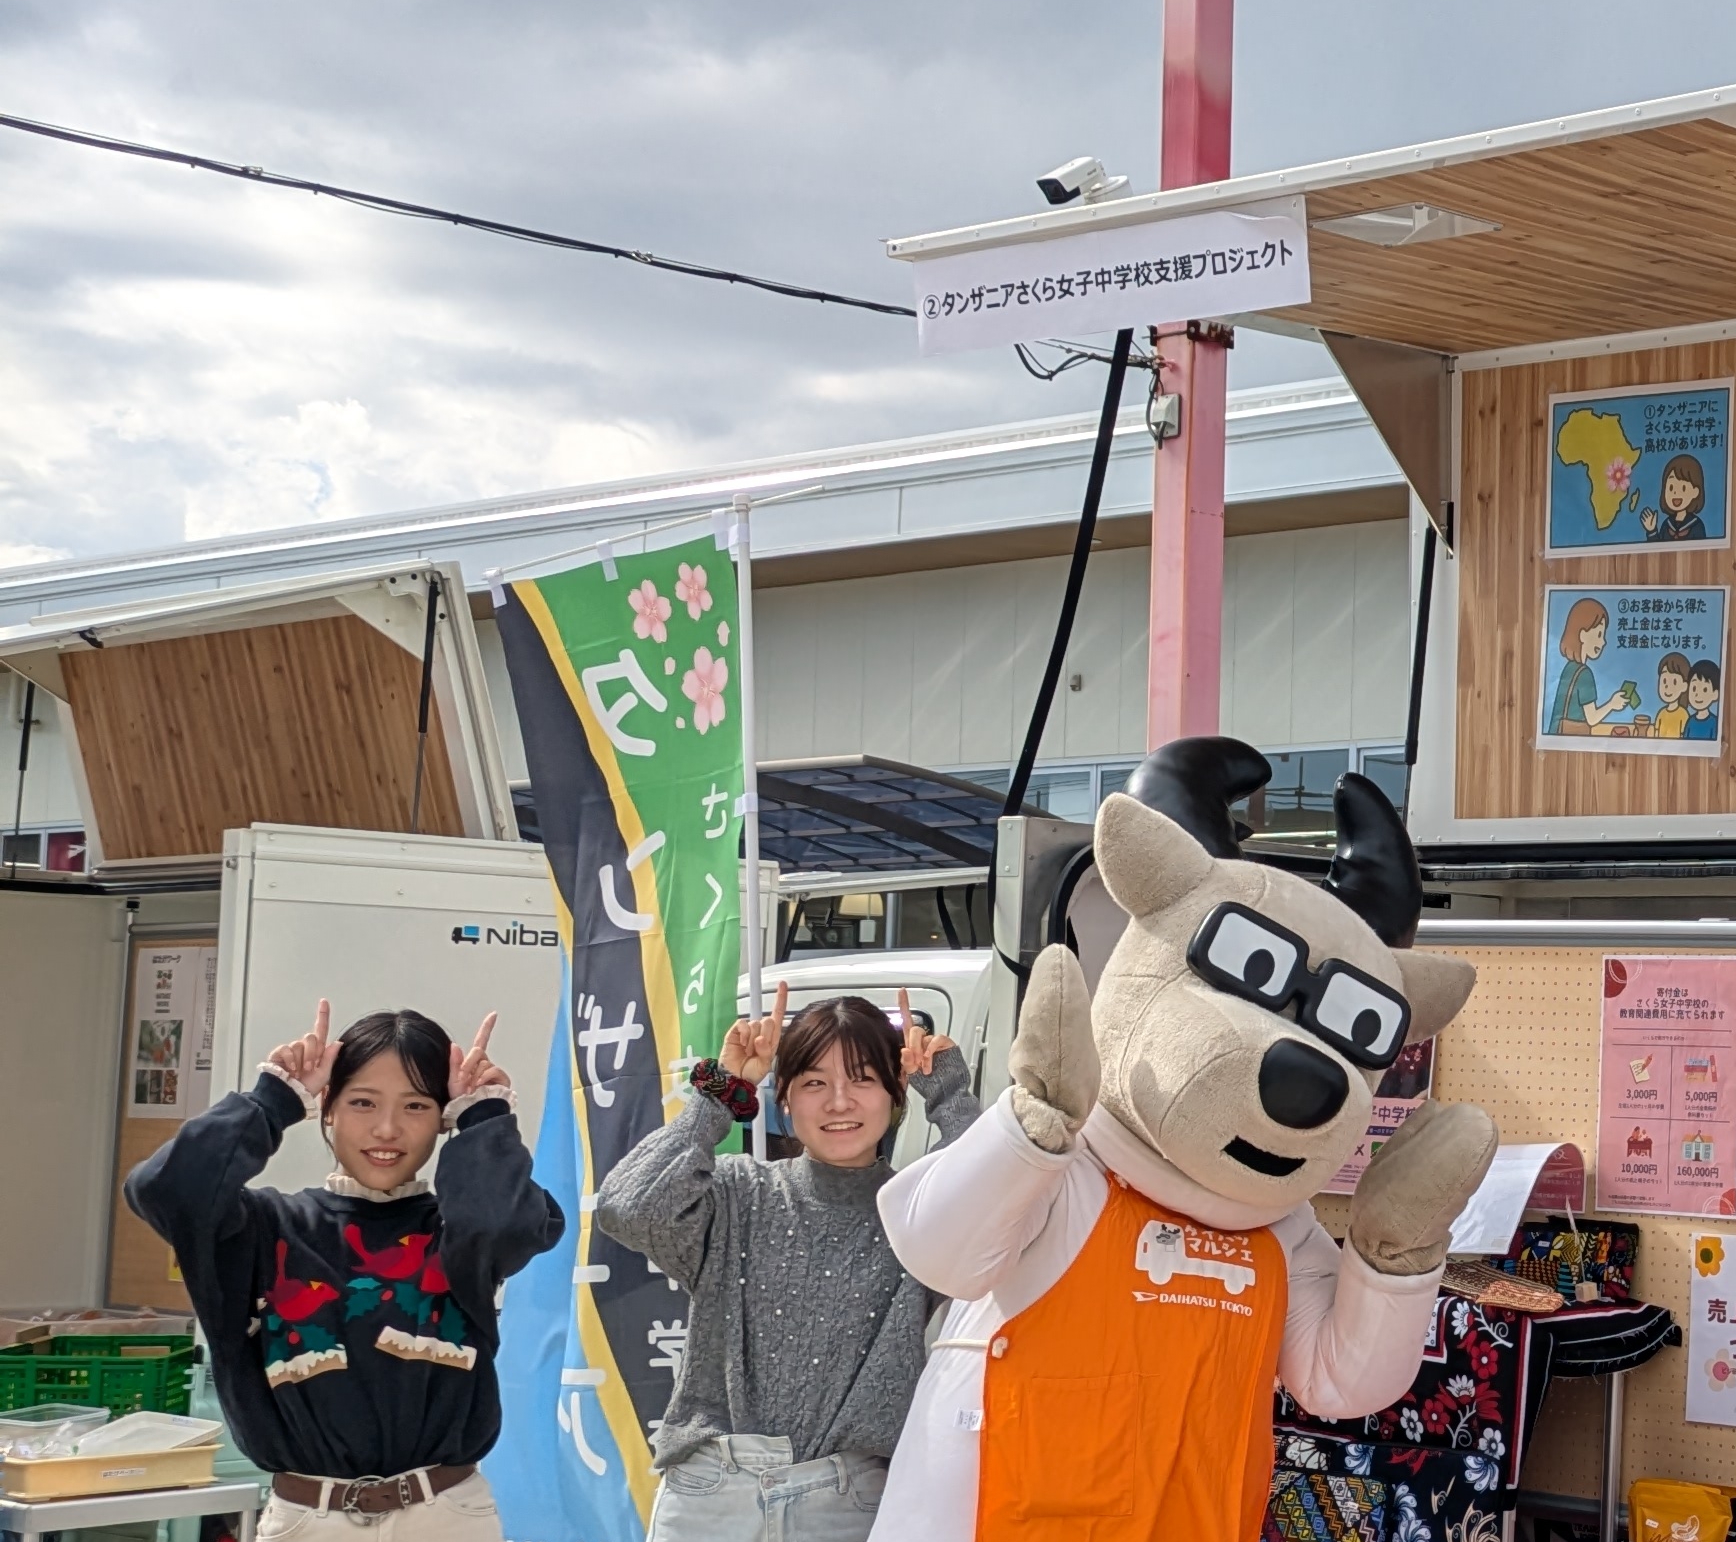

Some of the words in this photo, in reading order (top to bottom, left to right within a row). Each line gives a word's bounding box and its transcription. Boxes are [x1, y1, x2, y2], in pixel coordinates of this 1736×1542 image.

[923, 240, 1293, 319] ②タンザニアさくら女子中学校支援プロジェクト
[1626, 1089, 1657, 1100] 3,000円
[1685, 1091, 1717, 1102] 5,000円
[1621, 1163, 1657, 1175] 10,000円
[1160, 1293, 1216, 1307] DAIHATSU
[1220, 1300, 1252, 1316] TOKYO
